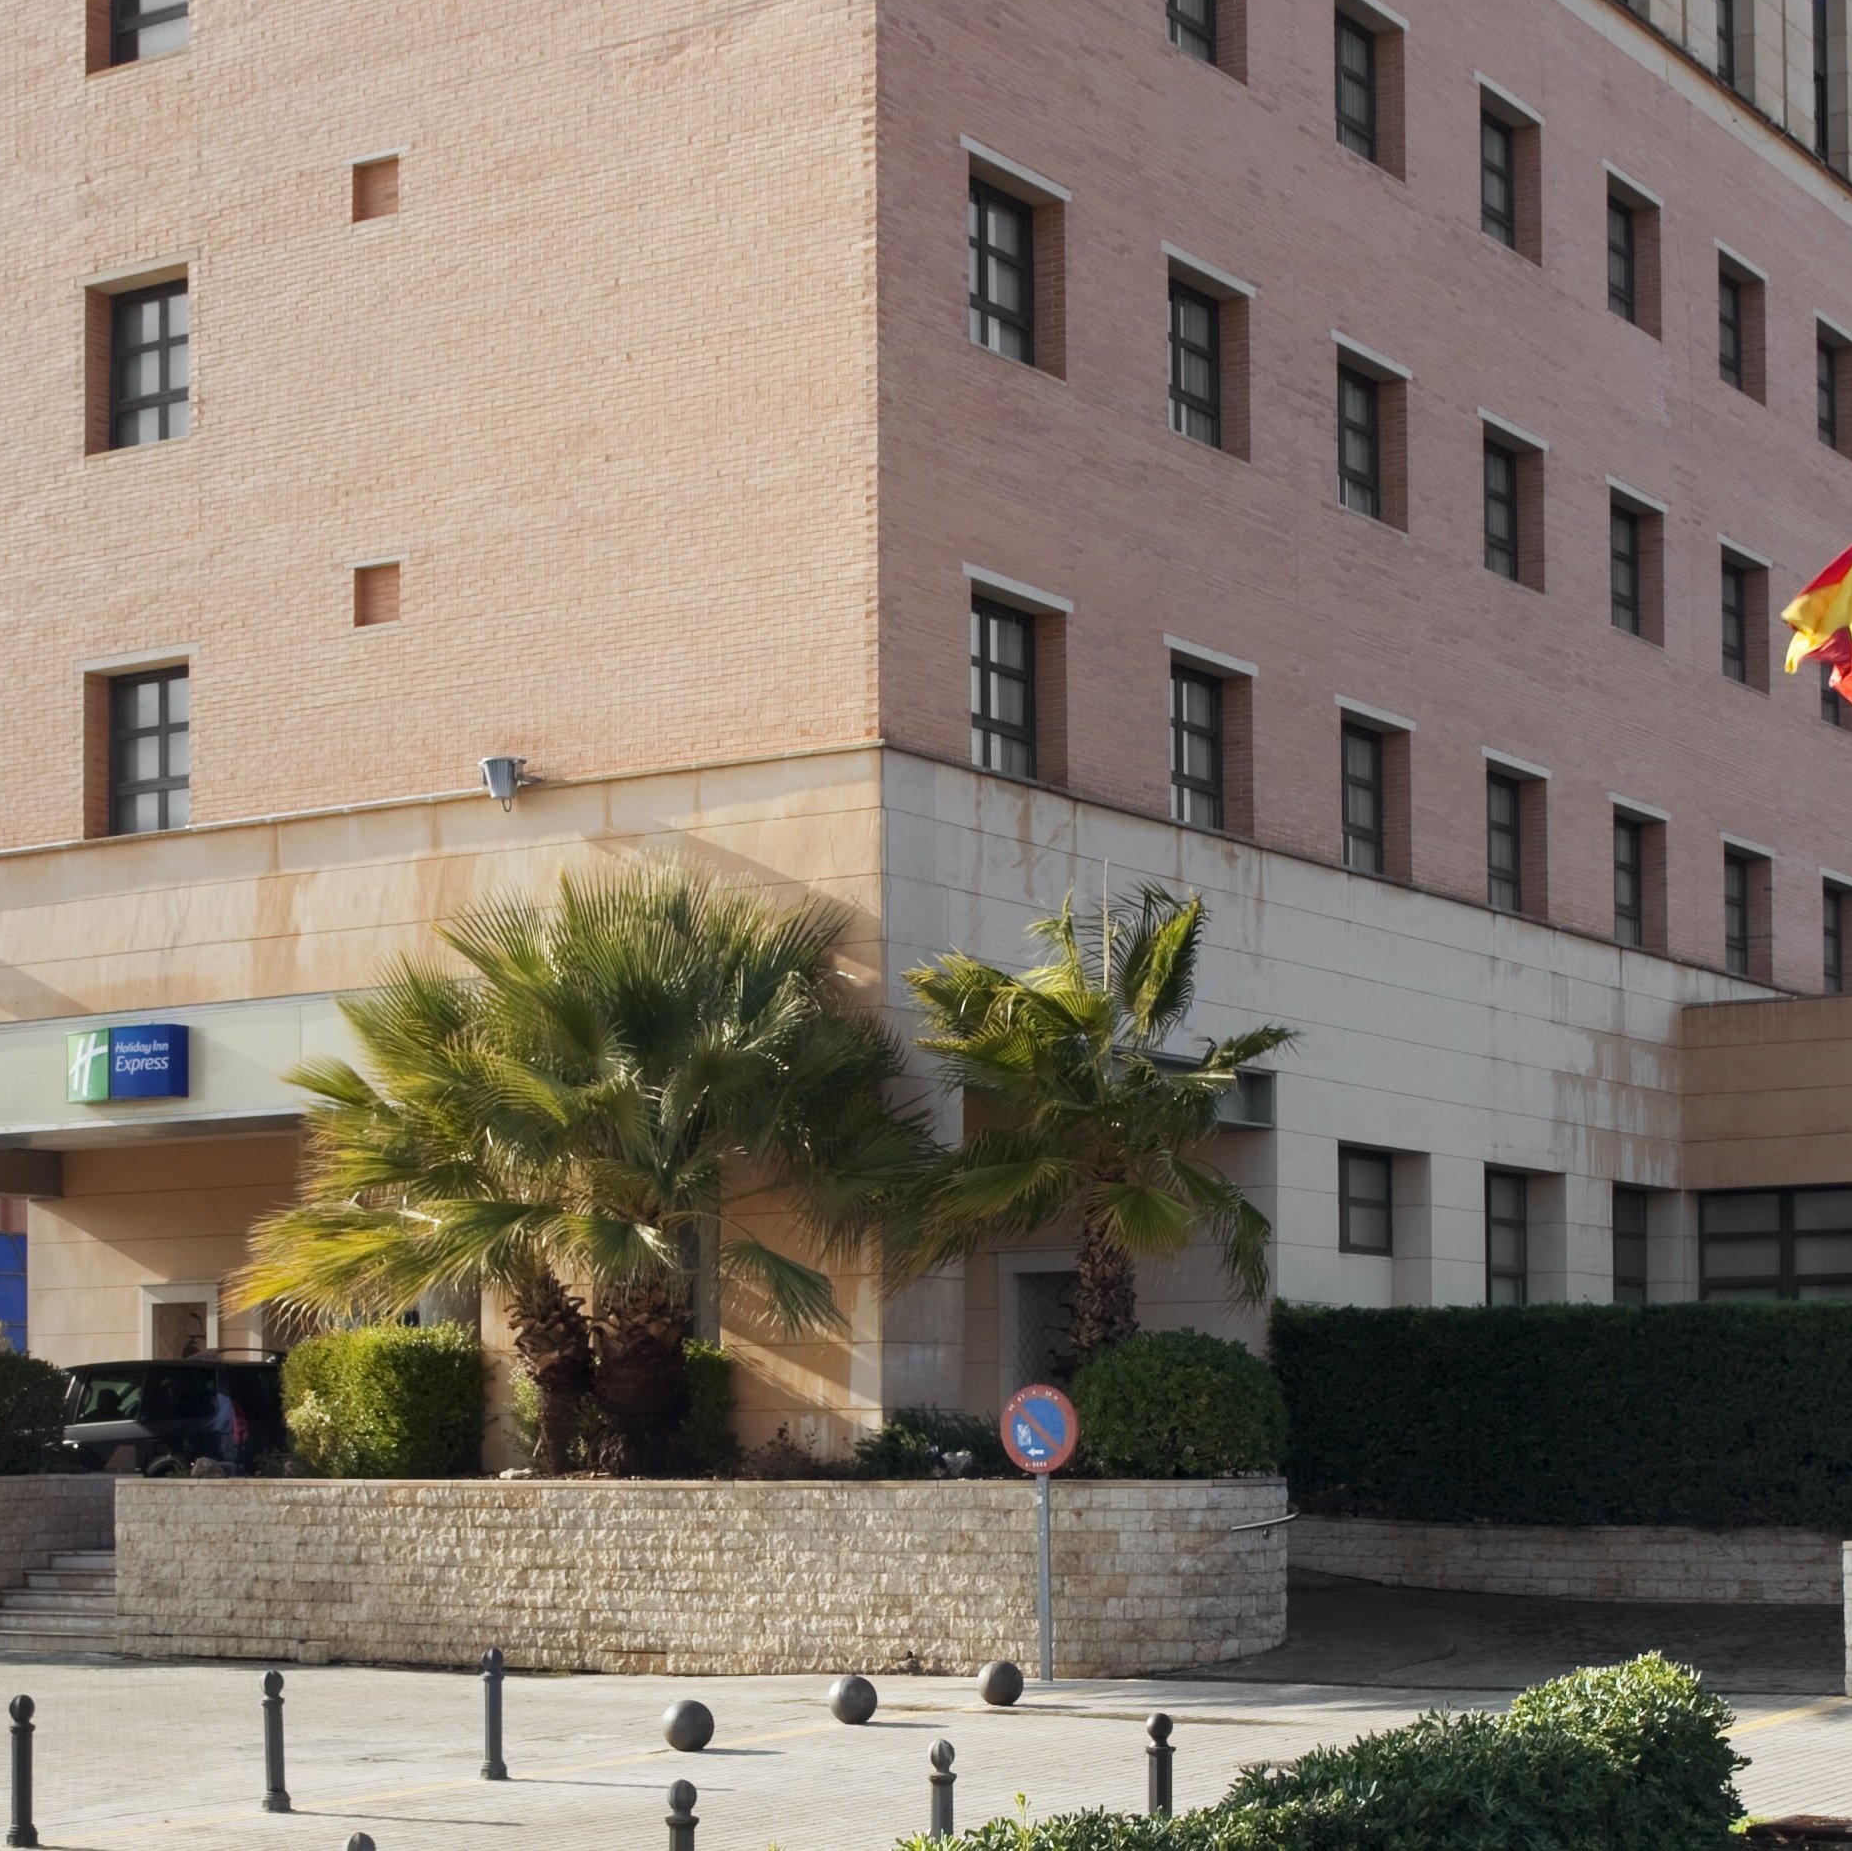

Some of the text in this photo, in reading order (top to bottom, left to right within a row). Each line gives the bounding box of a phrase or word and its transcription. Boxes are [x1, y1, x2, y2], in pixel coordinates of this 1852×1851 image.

[115, 1040, 169, 1055] Holiday Inn
[115, 1055, 170, 1075] Express
